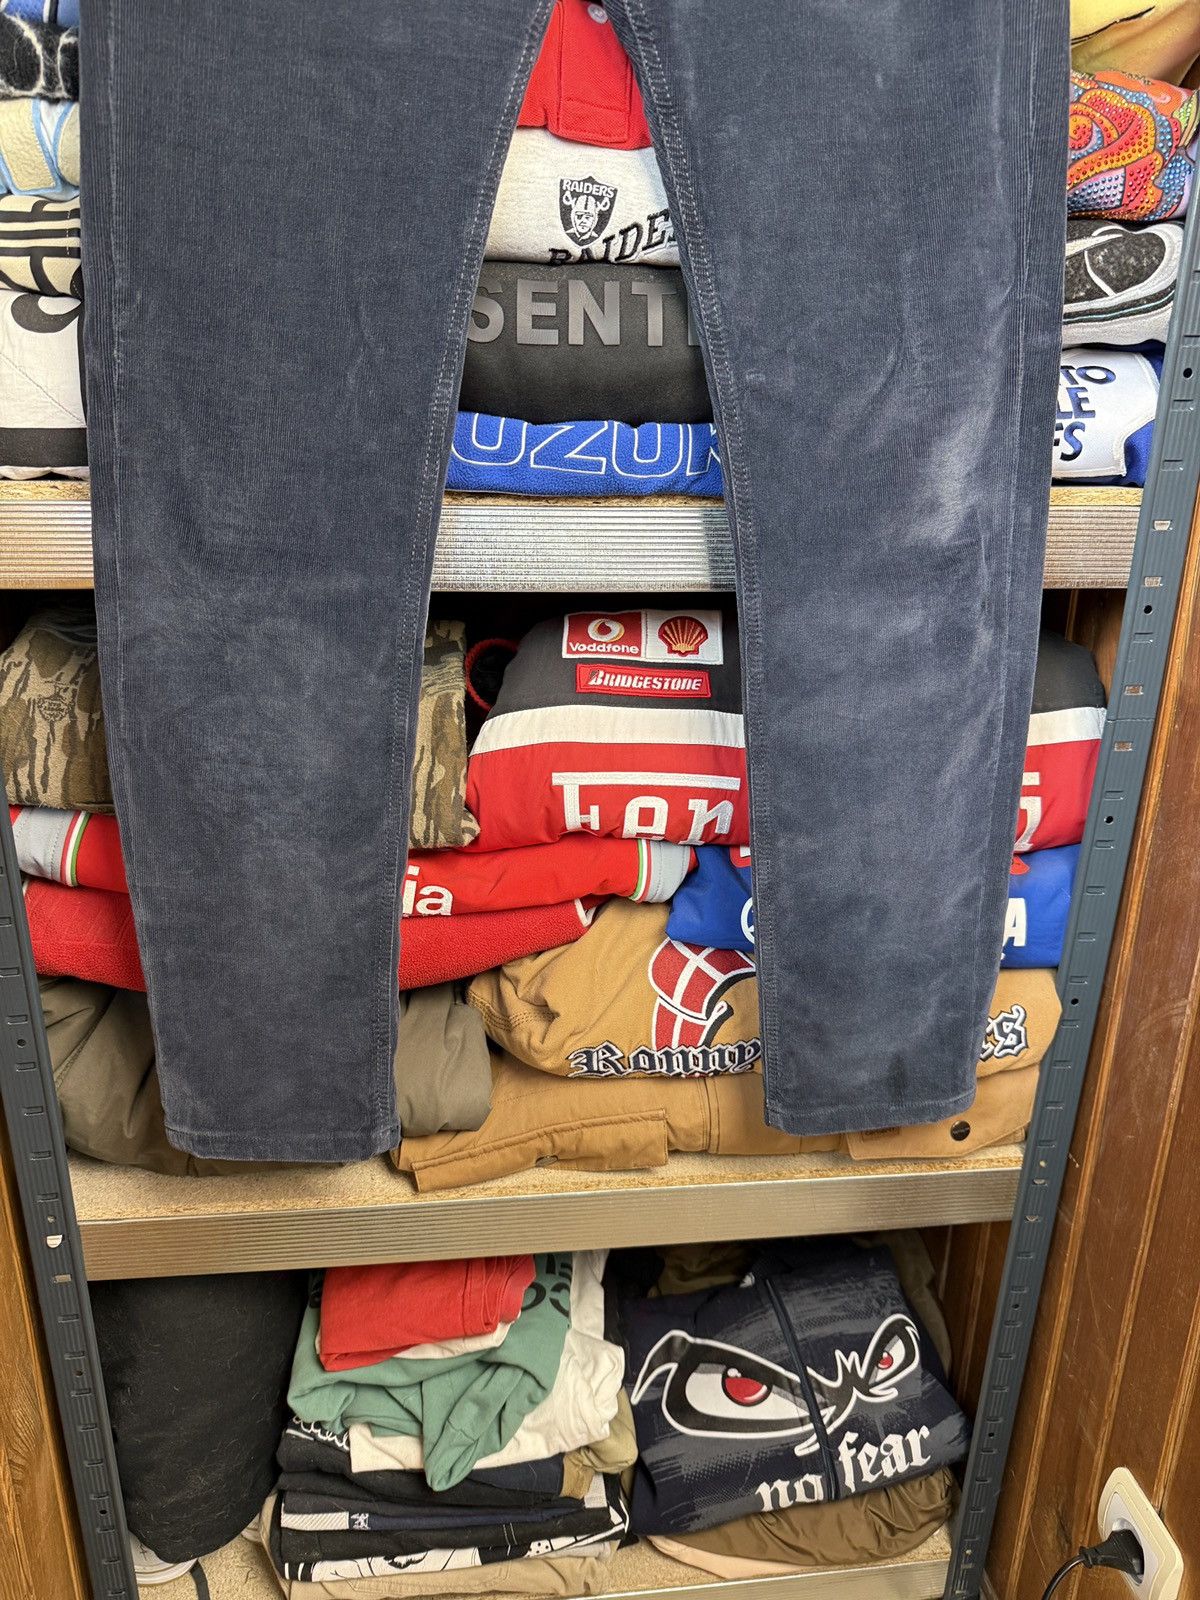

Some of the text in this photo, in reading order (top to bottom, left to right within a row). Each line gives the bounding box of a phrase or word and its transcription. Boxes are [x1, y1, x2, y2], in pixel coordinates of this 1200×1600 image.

[562, 179, 616, 199] RAIDERS
[549, 208, 677, 264] RAIDE
[569, 641, 640, 655] Vodafone
[588, 669, 703, 691] BRIDGESTONE
[755, 1425, 931, 1512] no fear
